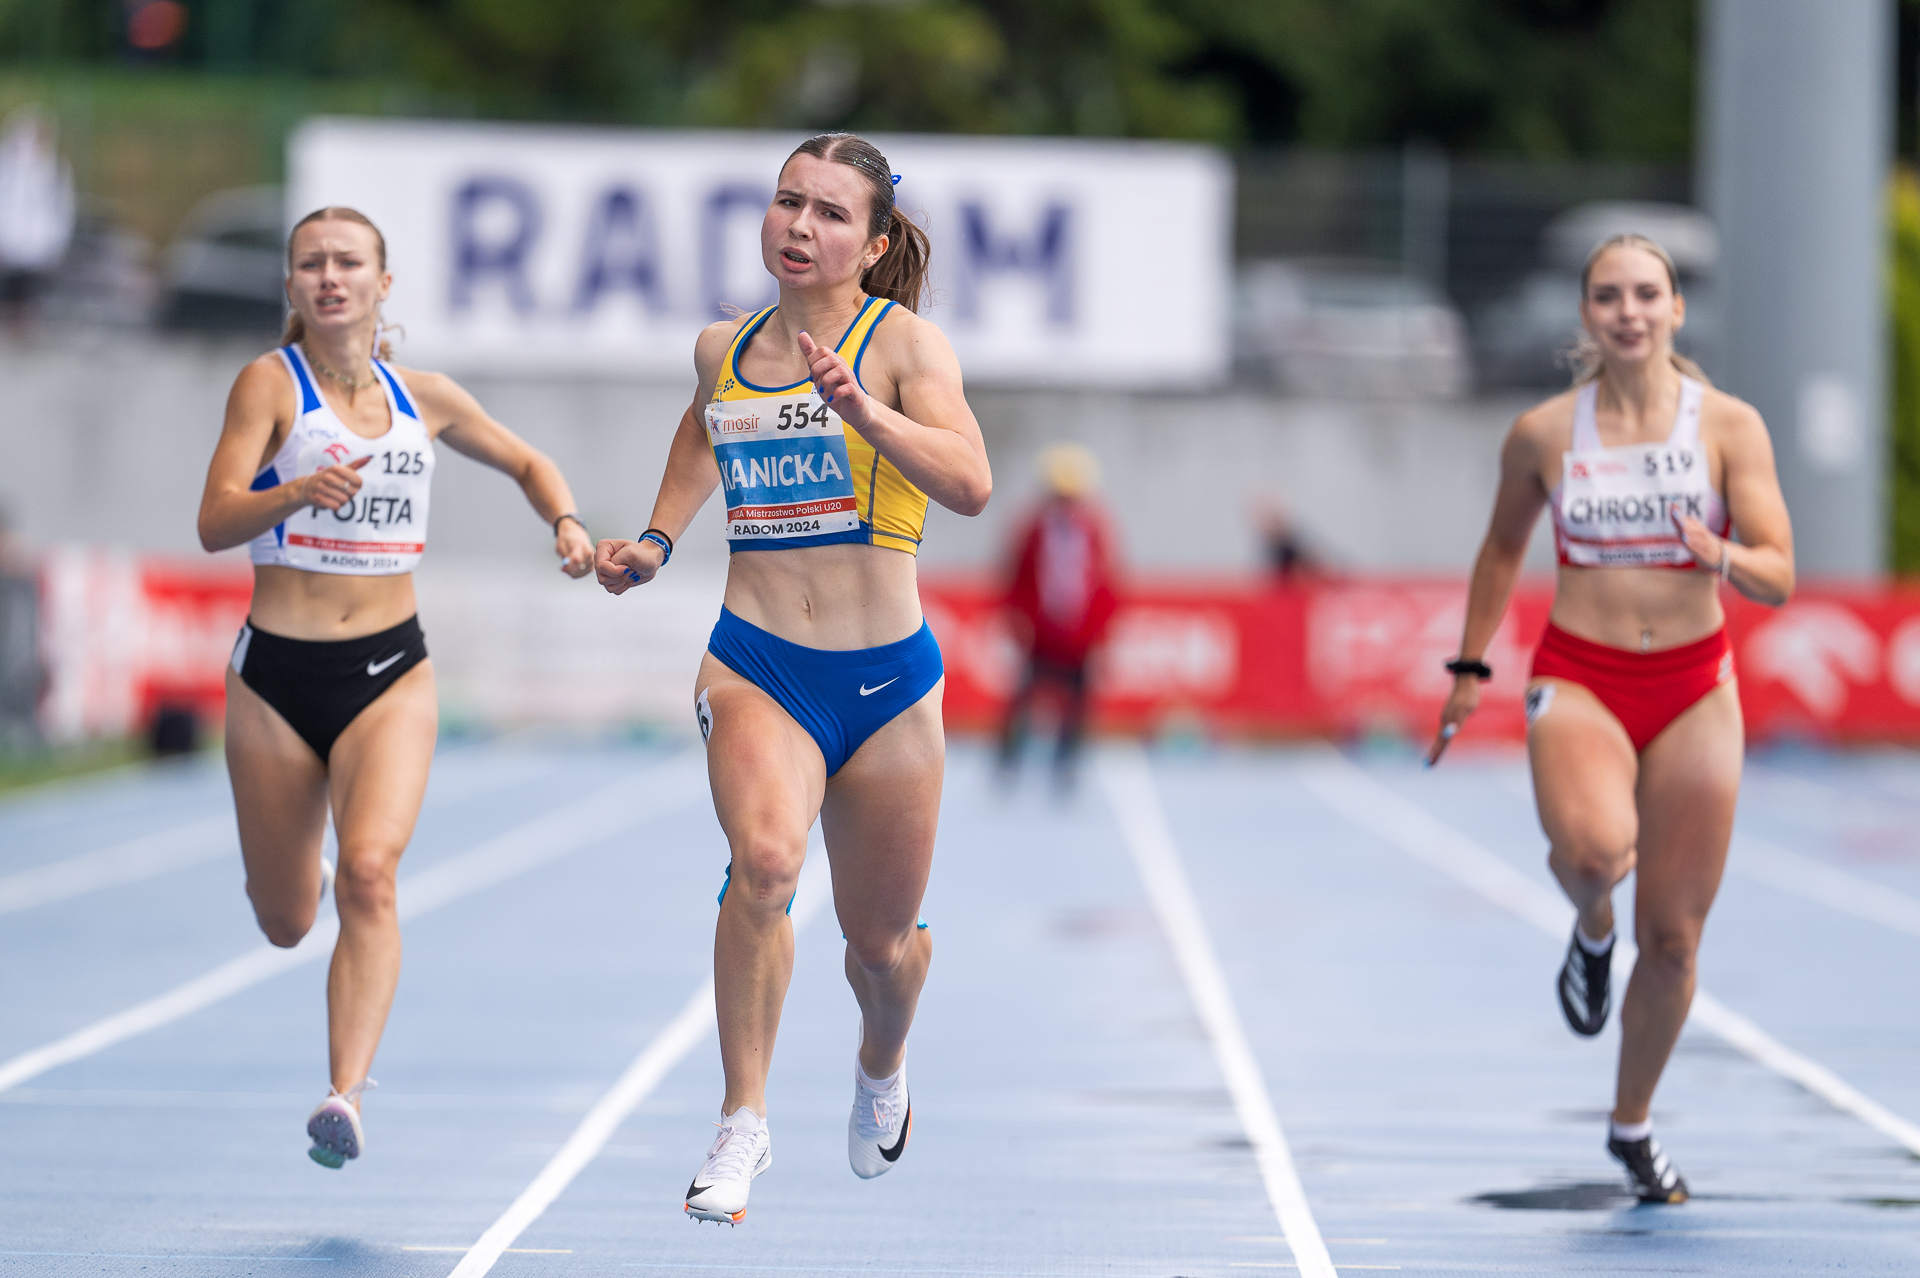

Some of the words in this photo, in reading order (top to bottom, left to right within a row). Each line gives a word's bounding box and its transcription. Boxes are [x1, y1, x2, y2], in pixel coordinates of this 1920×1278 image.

[446, 172, 1077, 326] RADM
[723, 413, 760, 432] mosir
[776, 402, 829, 431] 554
[383, 451, 425, 475] 125
[720, 451, 845, 492] KANICKA
[1644, 450, 1693, 476] 519
[746, 508, 795, 518] Mistrzostwa
[796, 504, 822, 515] Polski
[824, 501, 842, 511] U20
[734, 523, 784, 536] RADOM
[786, 519, 821, 533] 2024
